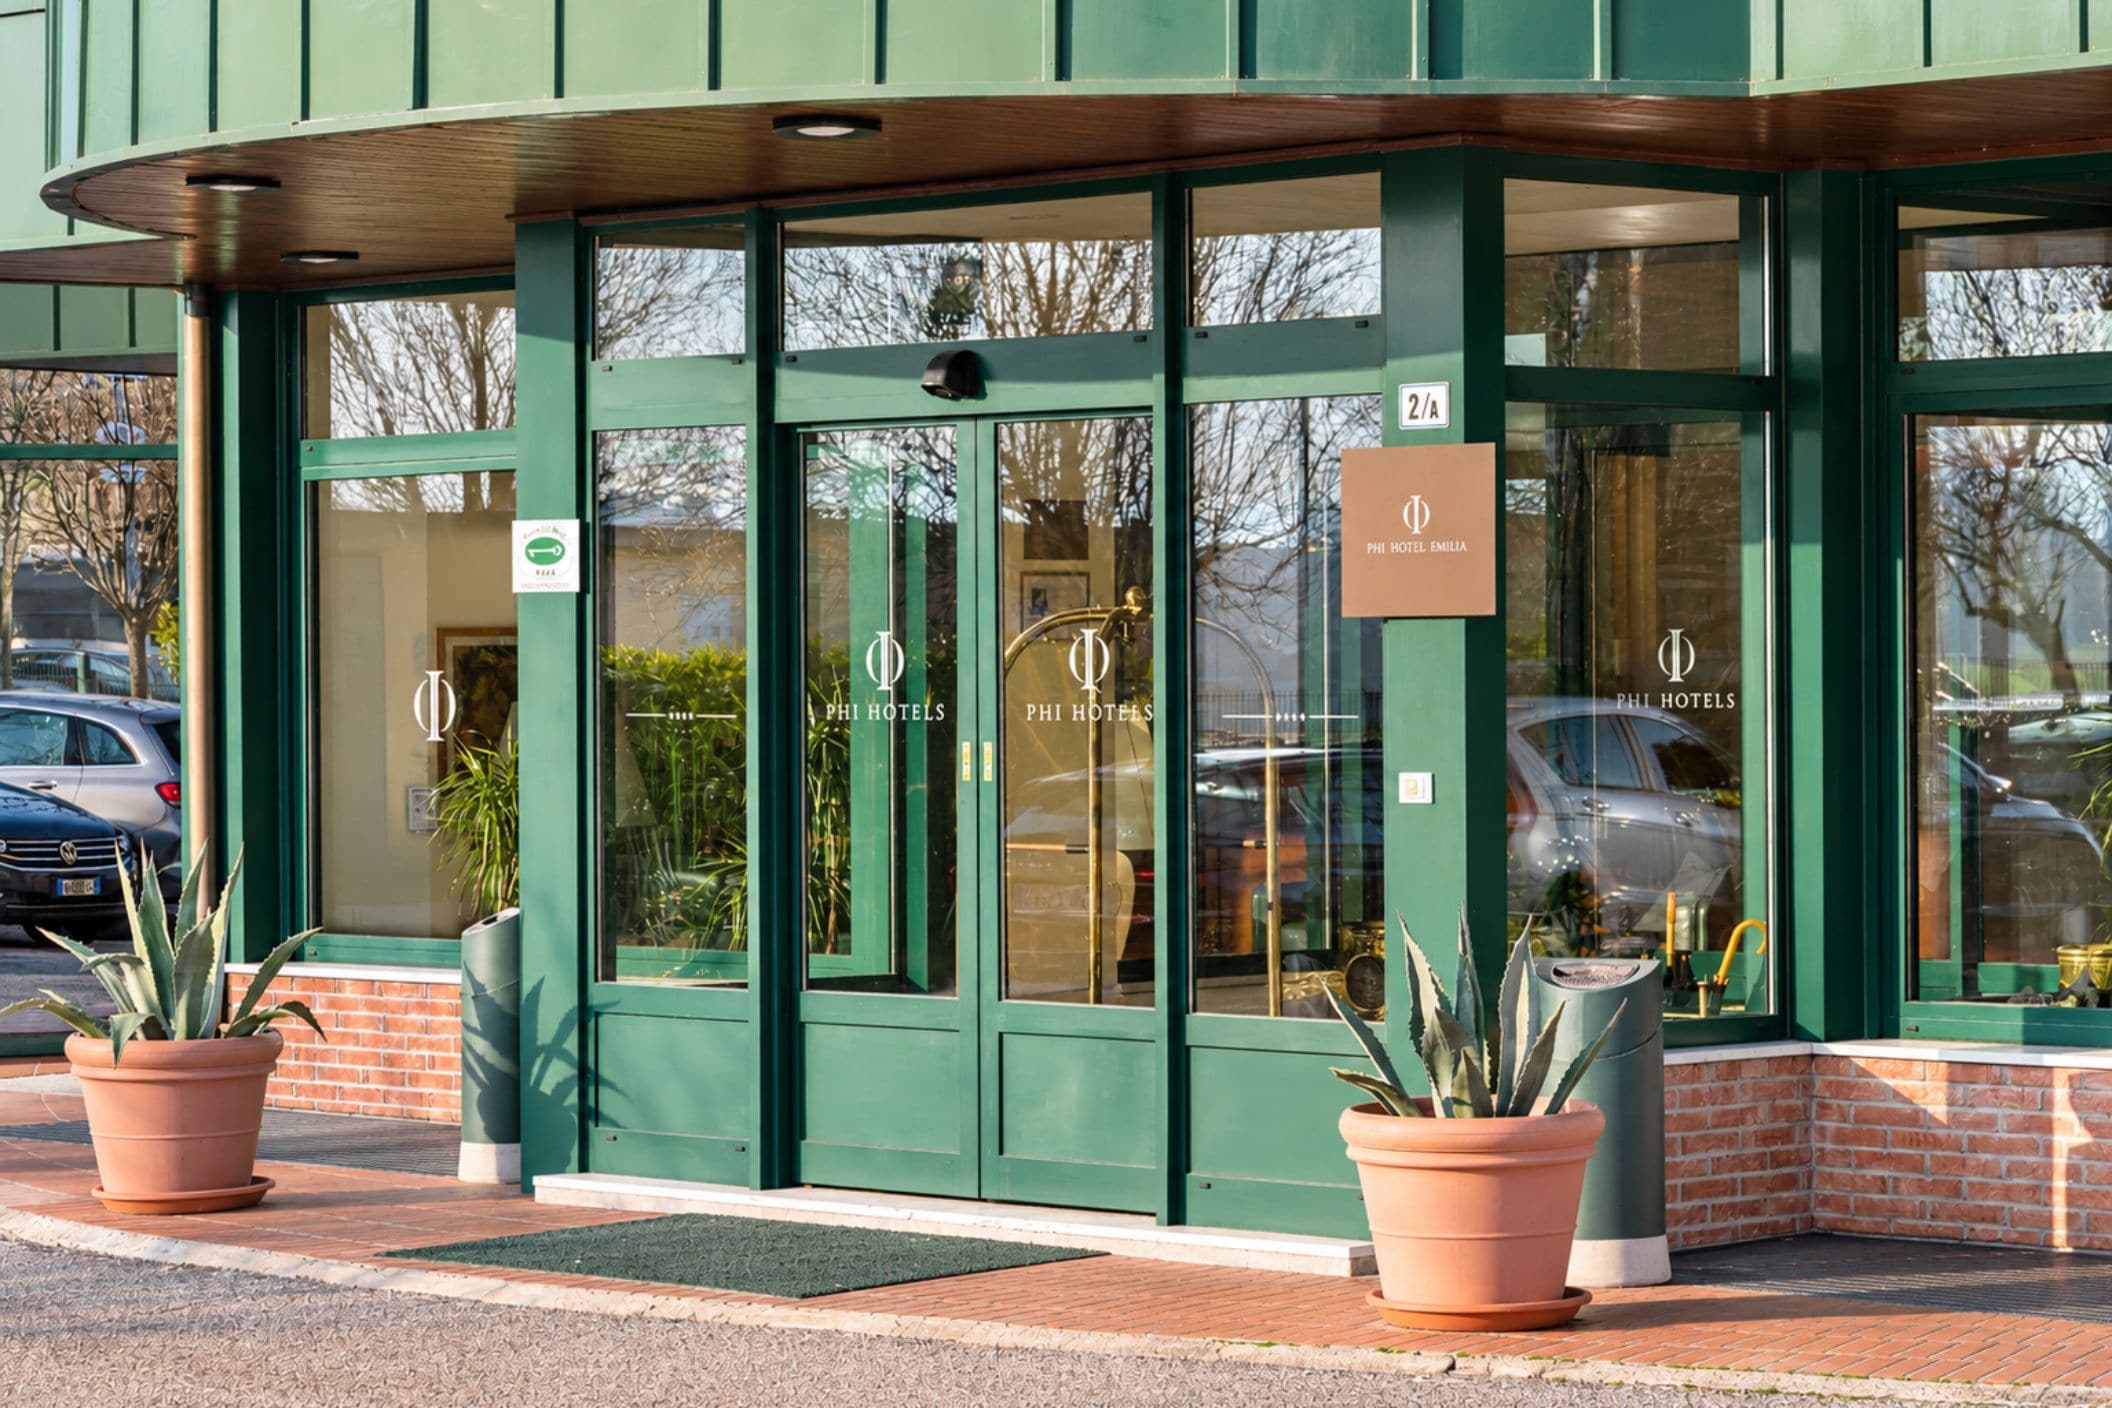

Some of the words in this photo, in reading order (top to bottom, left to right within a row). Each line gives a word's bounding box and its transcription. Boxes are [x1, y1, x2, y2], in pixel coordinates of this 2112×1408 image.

[1408, 392, 1439, 420] 2/A
[1367, 542, 1385, 554] PHI
[1391, 541, 1426, 553] HOTEL
[1430, 540, 1468, 553] EMILIA
[1616, 692, 1649, 709] PHI
[1661, 692, 1735, 709] HOTELS
[826, 703, 858, 720] PHI
[868, 703, 945, 721] HOTELS
[1026, 703, 1061, 721] PHI
[1072, 703, 1153, 721] HOTELS
